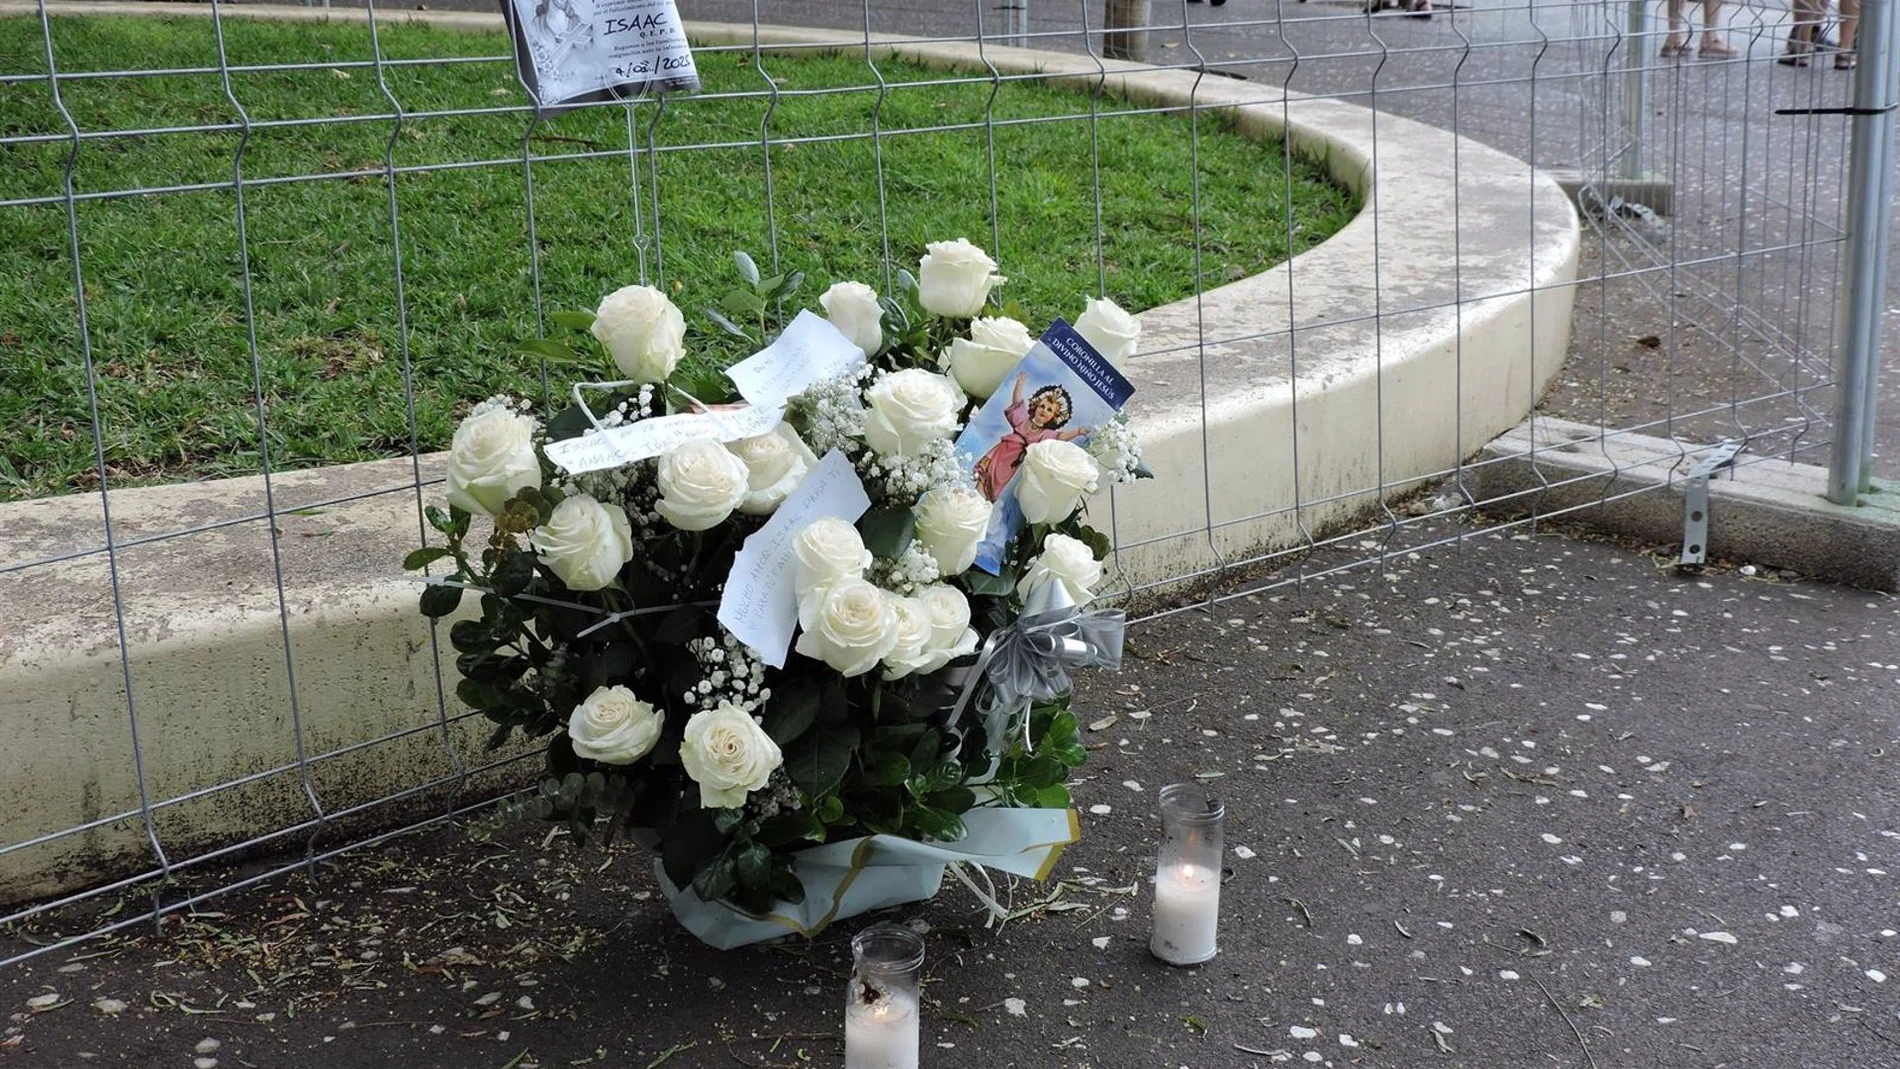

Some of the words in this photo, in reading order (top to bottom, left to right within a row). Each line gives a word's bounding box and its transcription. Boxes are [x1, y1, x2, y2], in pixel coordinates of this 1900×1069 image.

[603, 12, 667, 36] ISAAC
[1052, 338, 1079, 365] DIVINO
[1066, 337, 1105, 377] CORONILLA
[1103, 375, 1114, 385] AL
